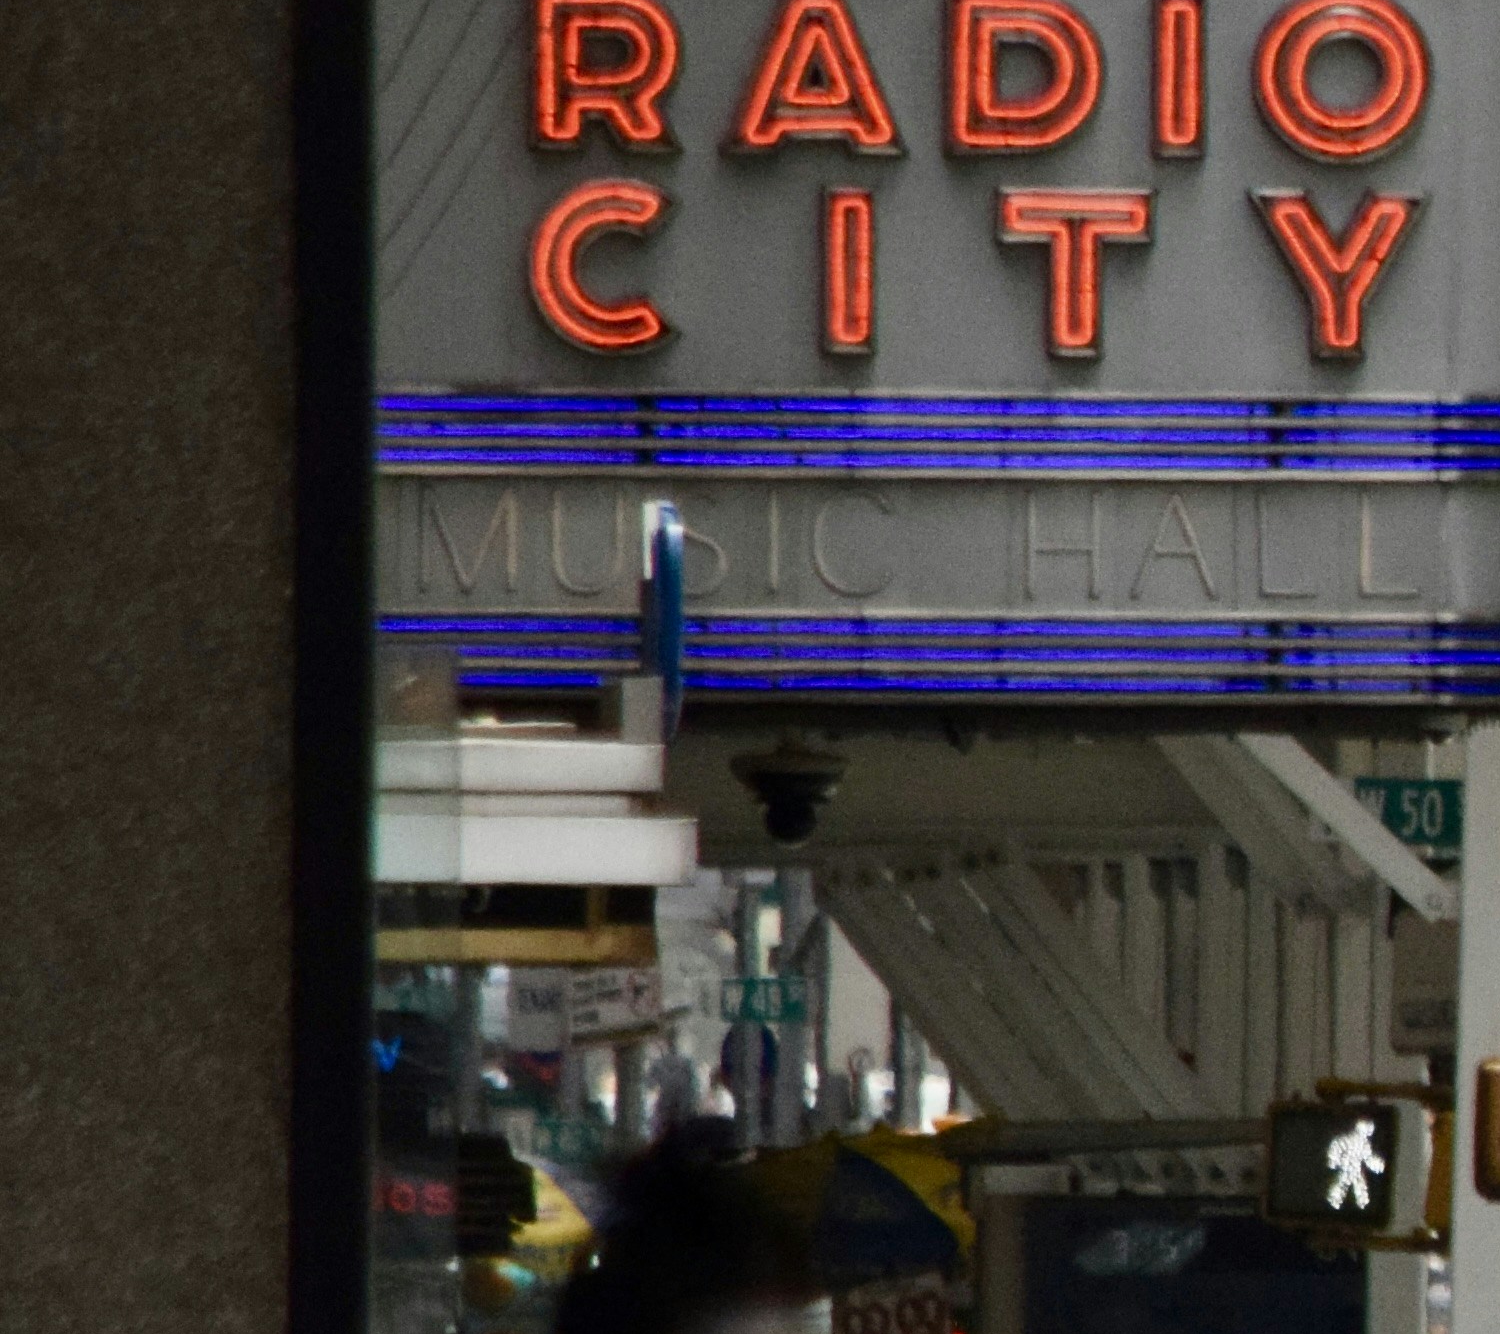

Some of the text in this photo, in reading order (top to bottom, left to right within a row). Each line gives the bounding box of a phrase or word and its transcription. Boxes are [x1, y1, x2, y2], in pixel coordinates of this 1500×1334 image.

[530, 178, 1426, 358] CITY
[417, 486, 1421, 599] MUSIC HALL
[1400, 789, 1443, 838] 50
